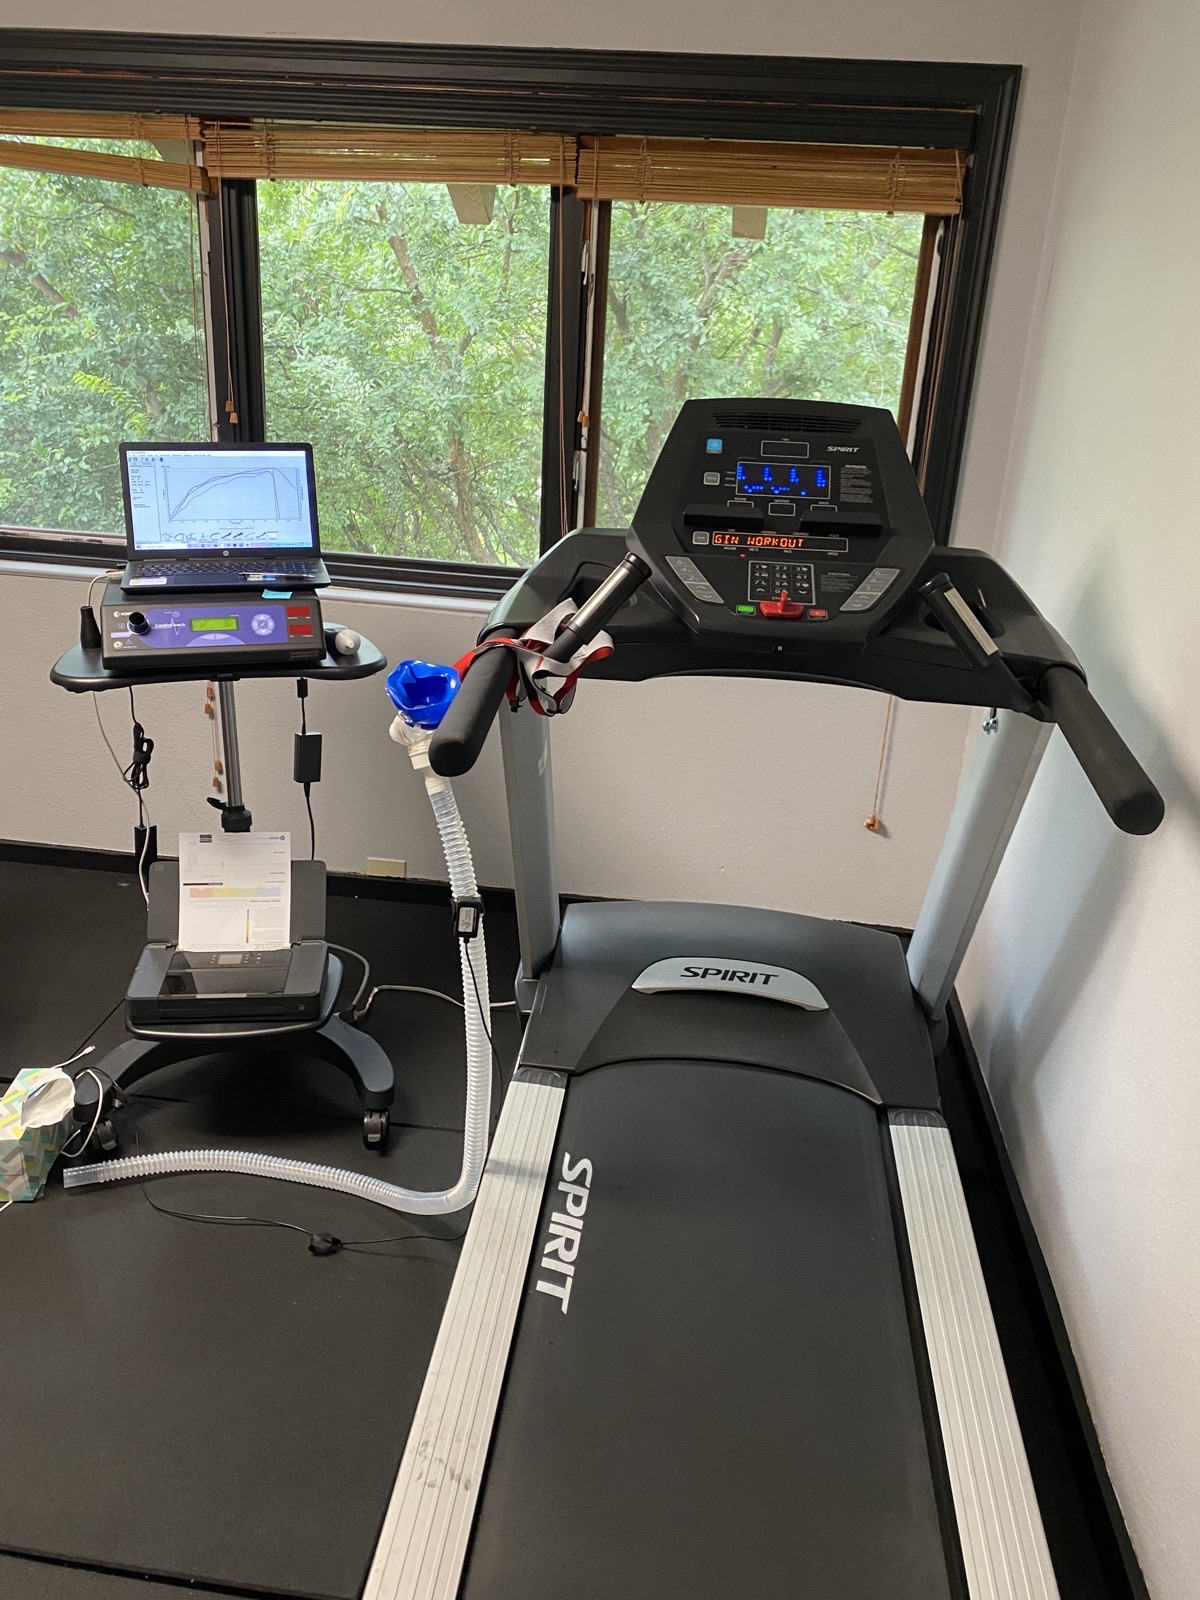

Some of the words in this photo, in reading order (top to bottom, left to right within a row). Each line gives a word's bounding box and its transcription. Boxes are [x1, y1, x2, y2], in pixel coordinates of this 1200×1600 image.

[826, 445, 860, 453] SPIRIT
[714, 534, 740, 545] GIN
[746, 536, 804, 548] WORKOUT
[680, 966, 779, 985] SPIRIT
[536, 1151, 593, 1315] SPIRIT
